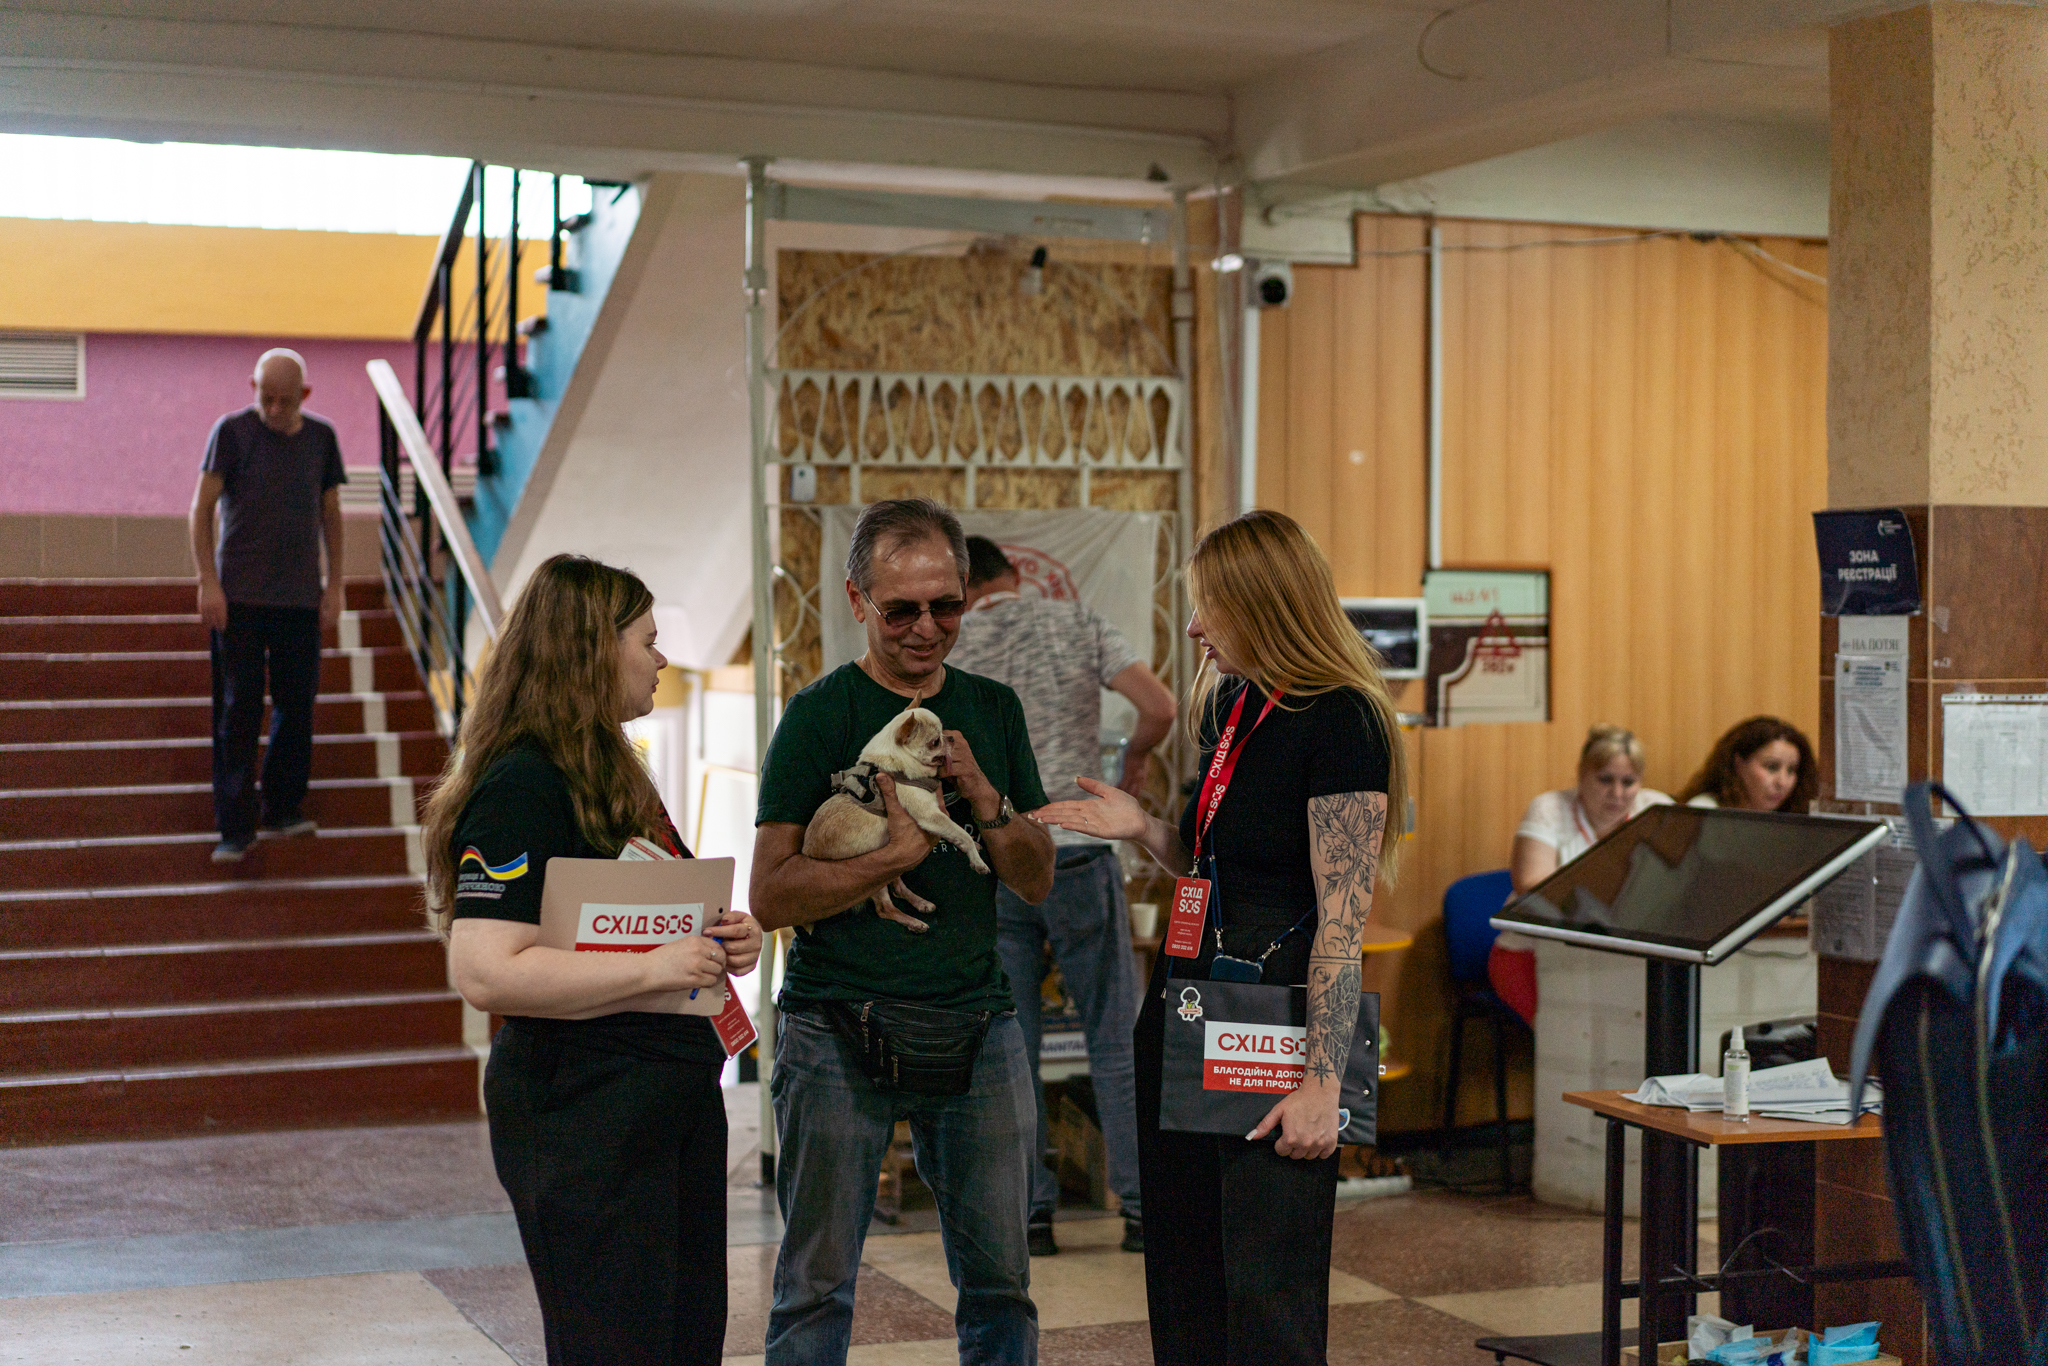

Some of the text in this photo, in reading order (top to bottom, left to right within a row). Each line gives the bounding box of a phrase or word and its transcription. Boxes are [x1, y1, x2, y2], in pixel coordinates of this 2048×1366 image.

[1849, 549, 1880, 563] ЗОНА
[1838, 563, 1897, 582] РЕЄСТРАЦІЇ
[1852, 638, 1866, 650] НА
[1209, 725, 1235, 778] СХІД SOS
[1209, 783, 1226, 809] SOS
[1180, 886, 1203, 899] СХІД
[1178, 898, 1201, 914] SOS
[592, 913, 693, 934] СХІД SOS
[1217, 1033, 1276, 1054] СХІД
[1213, 1065, 1304, 1079] БЛАГОДІЙНА ДОПО
[1229, 1077, 1241, 1086] НЕ
[1243, 1078, 1263, 1088] ДЛЯ
